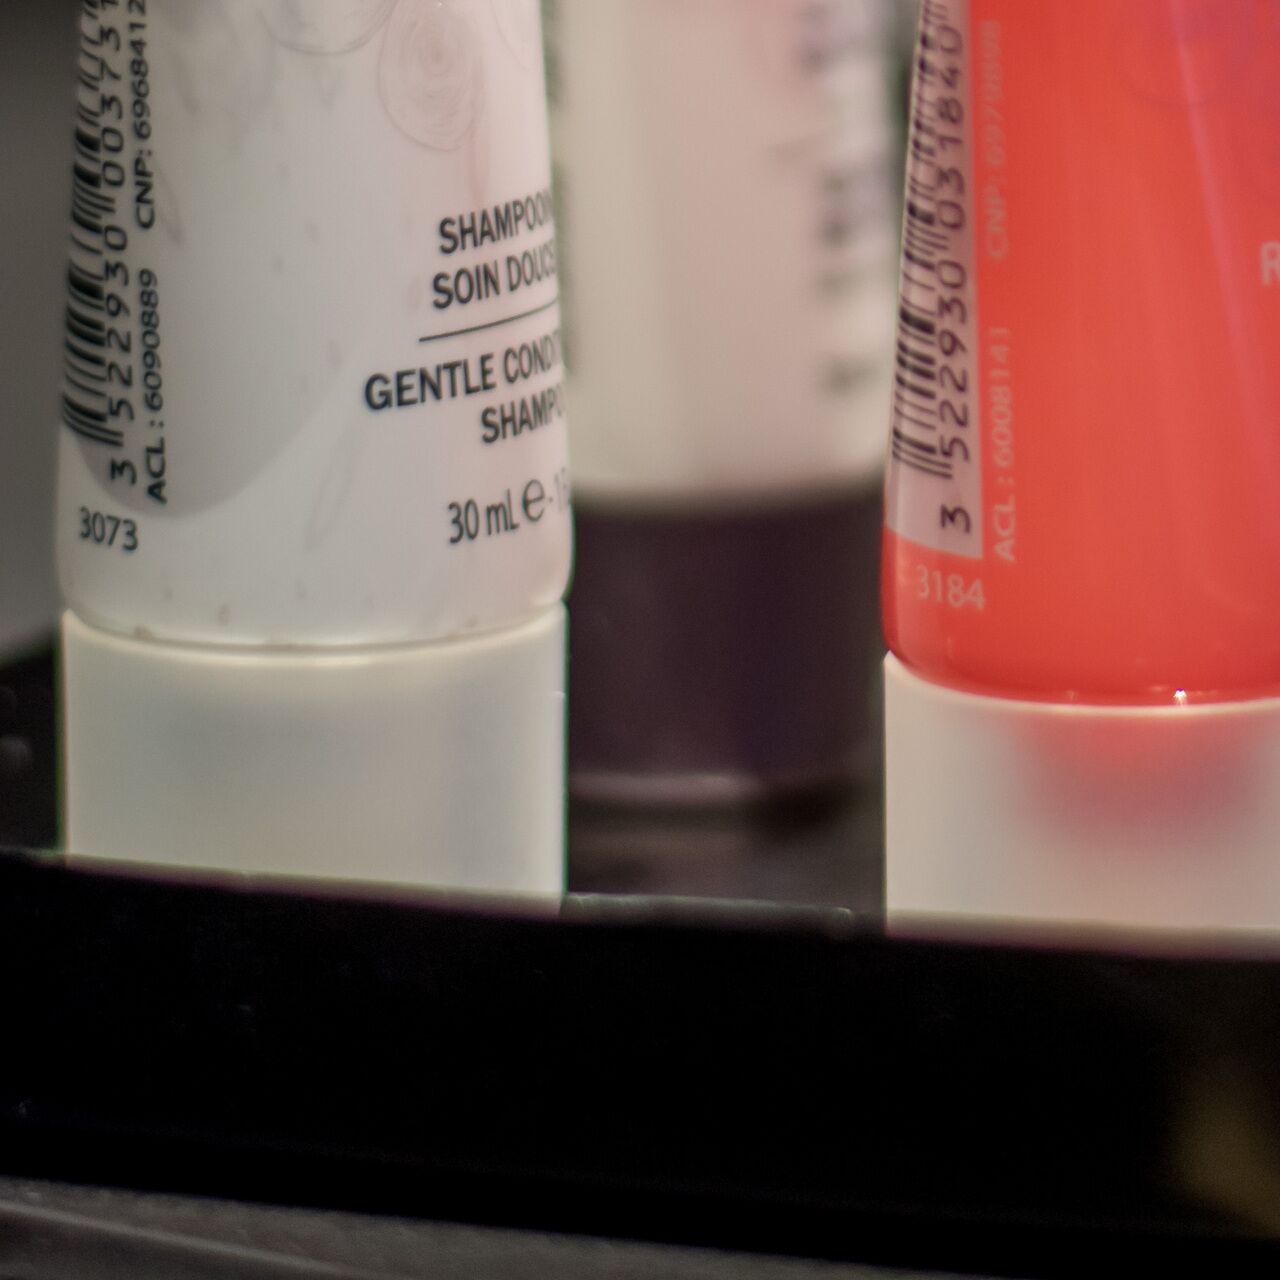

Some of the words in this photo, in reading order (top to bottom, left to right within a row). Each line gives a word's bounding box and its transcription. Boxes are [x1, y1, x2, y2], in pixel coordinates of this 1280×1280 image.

[432, 259, 500, 310] SOIN
[103, 224, 135, 422] 522930
[138, 268, 163, 413] 6090889
[364, 352, 497, 412] GENTLE
[937, 258, 971, 463] 522930
[109, 458, 137, 486] 3
[79, 506, 140, 552] 3073
[447, 498, 480, 545] 30
[940, 504, 972, 535] 3
[916, 564, 987, 613] 3184
